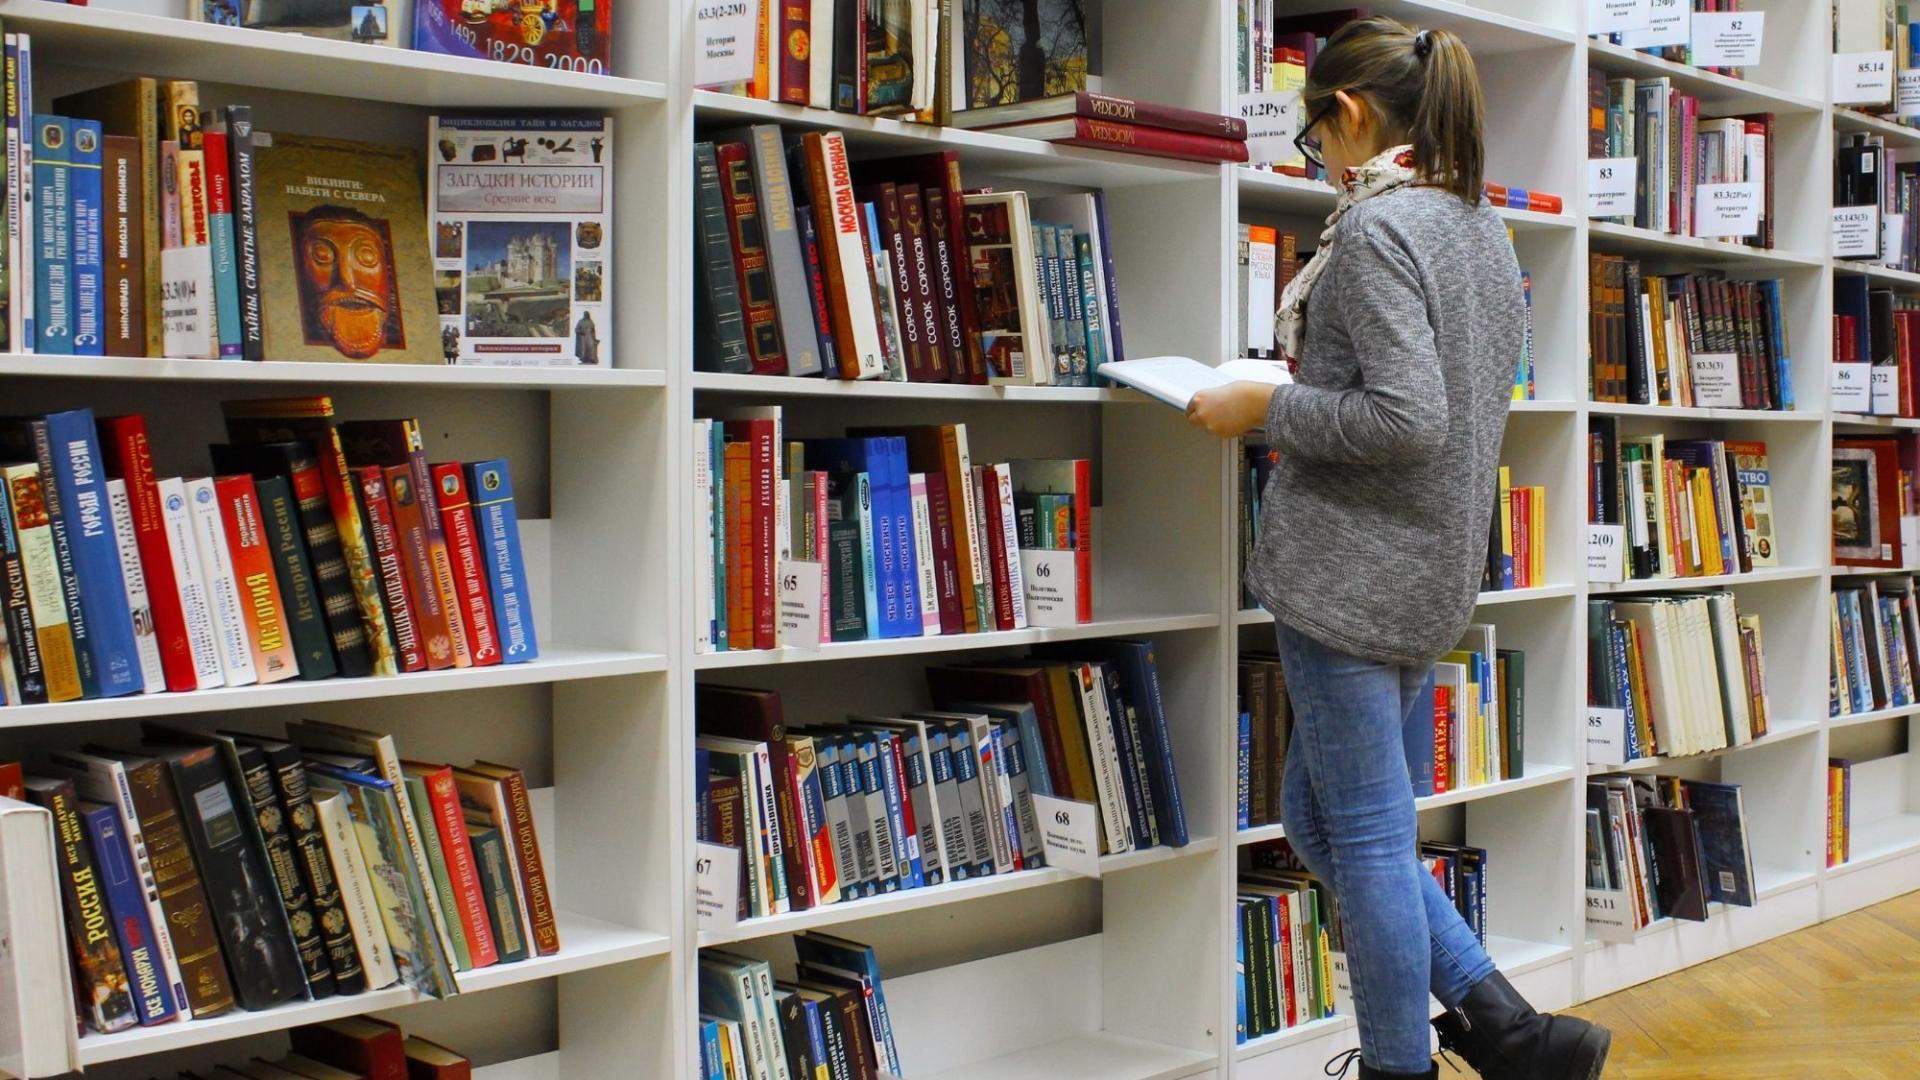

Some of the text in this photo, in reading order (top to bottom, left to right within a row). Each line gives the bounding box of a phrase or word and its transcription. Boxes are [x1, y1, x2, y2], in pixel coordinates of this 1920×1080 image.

[450, 19, 478, 51] 1492
[706, 35, 736, 48] История
[1731, 20, 1743, 31] 82
[485, 37, 535, 68] 1829
[544, 52, 603, 76] 2000
[706, 48, 735, 60] Москвы
[1858, 62, 1885, 73] 85.14
[6, 57, 16, 118] СДЕЛАЙ САМ!
[1090, 99, 1136, 121] МОСКВА
[1241, 103, 1287, 118] 81.2Рус
[441, 119, 517, 128] ЭНЦИКЛОПЕДИЯ
[521, 119, 545, 127] ТАЙН
[560, 120, 603, 128] ЗАГАДОК
[1090, 125, 1136, 145] МОСКВА
[1248, 130, 1267, 138] сский
[286, 184, 386, 204] НАБЕГИ С СЕВЕРА
[306, 175, 364, 190] ВИКИНГИ:
[447, 173, 594, 189] ЗАГАДКИ ИСТОРИИ
[832, 136, 858, 234] МОСКВА ВОЕННАЯ
[1599, 168, 1612, 179] 83
[214, 174, 230, 273] Средневековый мир
[484, 193, 557, 208] Средние века
[772, 184, 792, 232] МОСКВА
[117, 158, 130, 339] ВСЕМИРНАЯ ИСТОРИЯ СПРАВОЧНИК
[239, 152, 261, 342] ТАЙНЫ, СКРЫТЫЕ ЗАБРАЛОМ
[894, 233, 919, 342] СОРОК СОРОКОВ
[914, 238, 938, 344] СОРОК СОРОКОВ
[937, 241, 962, 348] СОРОК СОРОКОВ
[1083, 270, 1100, 332] ВЕСЬ МИР
[1838, 370, 1850, 380] 86
[72, 440, 104, 537] ГОРОДА РОССИИ
[127, 435, 151, 532] Иллюстрированная
[145, 489, 160, 530] история
[233, 497, 250, 547] Справочник
[241, 493, 260, 546] абитуриента
[964, 471, 981, 581] Экономическая азбука
[273, 496, 314, 621] История России
[413, 526, 428, 561] РОССИИ
[898, 516, 914, 619] МЫ ВСЕ МОСКВИЧИ
[999, 474, 1024, 619] ЭКОНОМИКА БИЗНЕС А-Я
[54, 520, 72, 574] ЦАРСКИЕ
[65, 575, 85, 640] ДИНАСТИИ
[452, 509, 496, 660] ЭНЦИКЛОПЕДИЯ МИР РУССКОЙ КУЛЬТУРЫ
[488, 504, 528, 656] ЭНЦИКЛОПЕДИЯ МИР РУССКОЙ ИСТОРИИ
[783, 574, 797, 591] 65
[880, 516, 898, 620] МЫ ВСЕ МОСКВИЧИ
[923, 568, 935, 598] Островская
[1036, 562, 1050, 578] 66
[8, 559, 41, 674] Памятные даты России
[246, 571, 284, 653] ИСТОРИЯ
[381, 552, 415, 652] ЭНЦИКЛОПЕДИЯ
[436, 550, 465, 656] РОССИЙСКАЯ ИМПЕРИЯ
[1001, 583, 1012, 620] РЫНОК:
[1588, 717, 1603, 727] 85
[1624, 688, 1640, 755] ИСКУССТВО
[1096, 741, 1114, 800] ЭНЦИКЛОПЕДИЯ
[508, 776, 530, 824] КУЛЬТУРЫ
[805, 783, 818, 834] СПРАВОЧНИК
[1055, 810, 1070, 826] 68
[1106, 801, 1122, 836] БОЛЬШАЯ
[67, 810, 83, 842] МИРА
[519, 826, 541, 873] РУССКОЙ
[766, 783, 788, 899] Справочник ПРИЗЫВНИКА
[874, 816, 895, 875] ЖЕНЩИНАМ
[921, 823, 938, 853] ДЕТЯХ
[943, 817, 959, 864] ОБРАТИТЕСЬ
[952, 815, 967, 854] АДВОКАТУ
[968, 808, 991, 861] ПРАВОСУДИЕ
[53, 794, 110, 945] РОССИЯ ВСЕ МОНАРХИ
[443, 800, 491, 956] ТЫСЯЧЕЛЕТИЕ РУССКОЙ ИСТОРИИ
[696, 857, 712, 875] 67
[529, 874, 550, 922] ИСТОРИЯ
[1586, 896, 1615, 910] 85.11
[132, 947, 166, 1019] ВСЕ МОНАРХИ
[824, 1010, 837, 1044] СЛОВАРЬ
